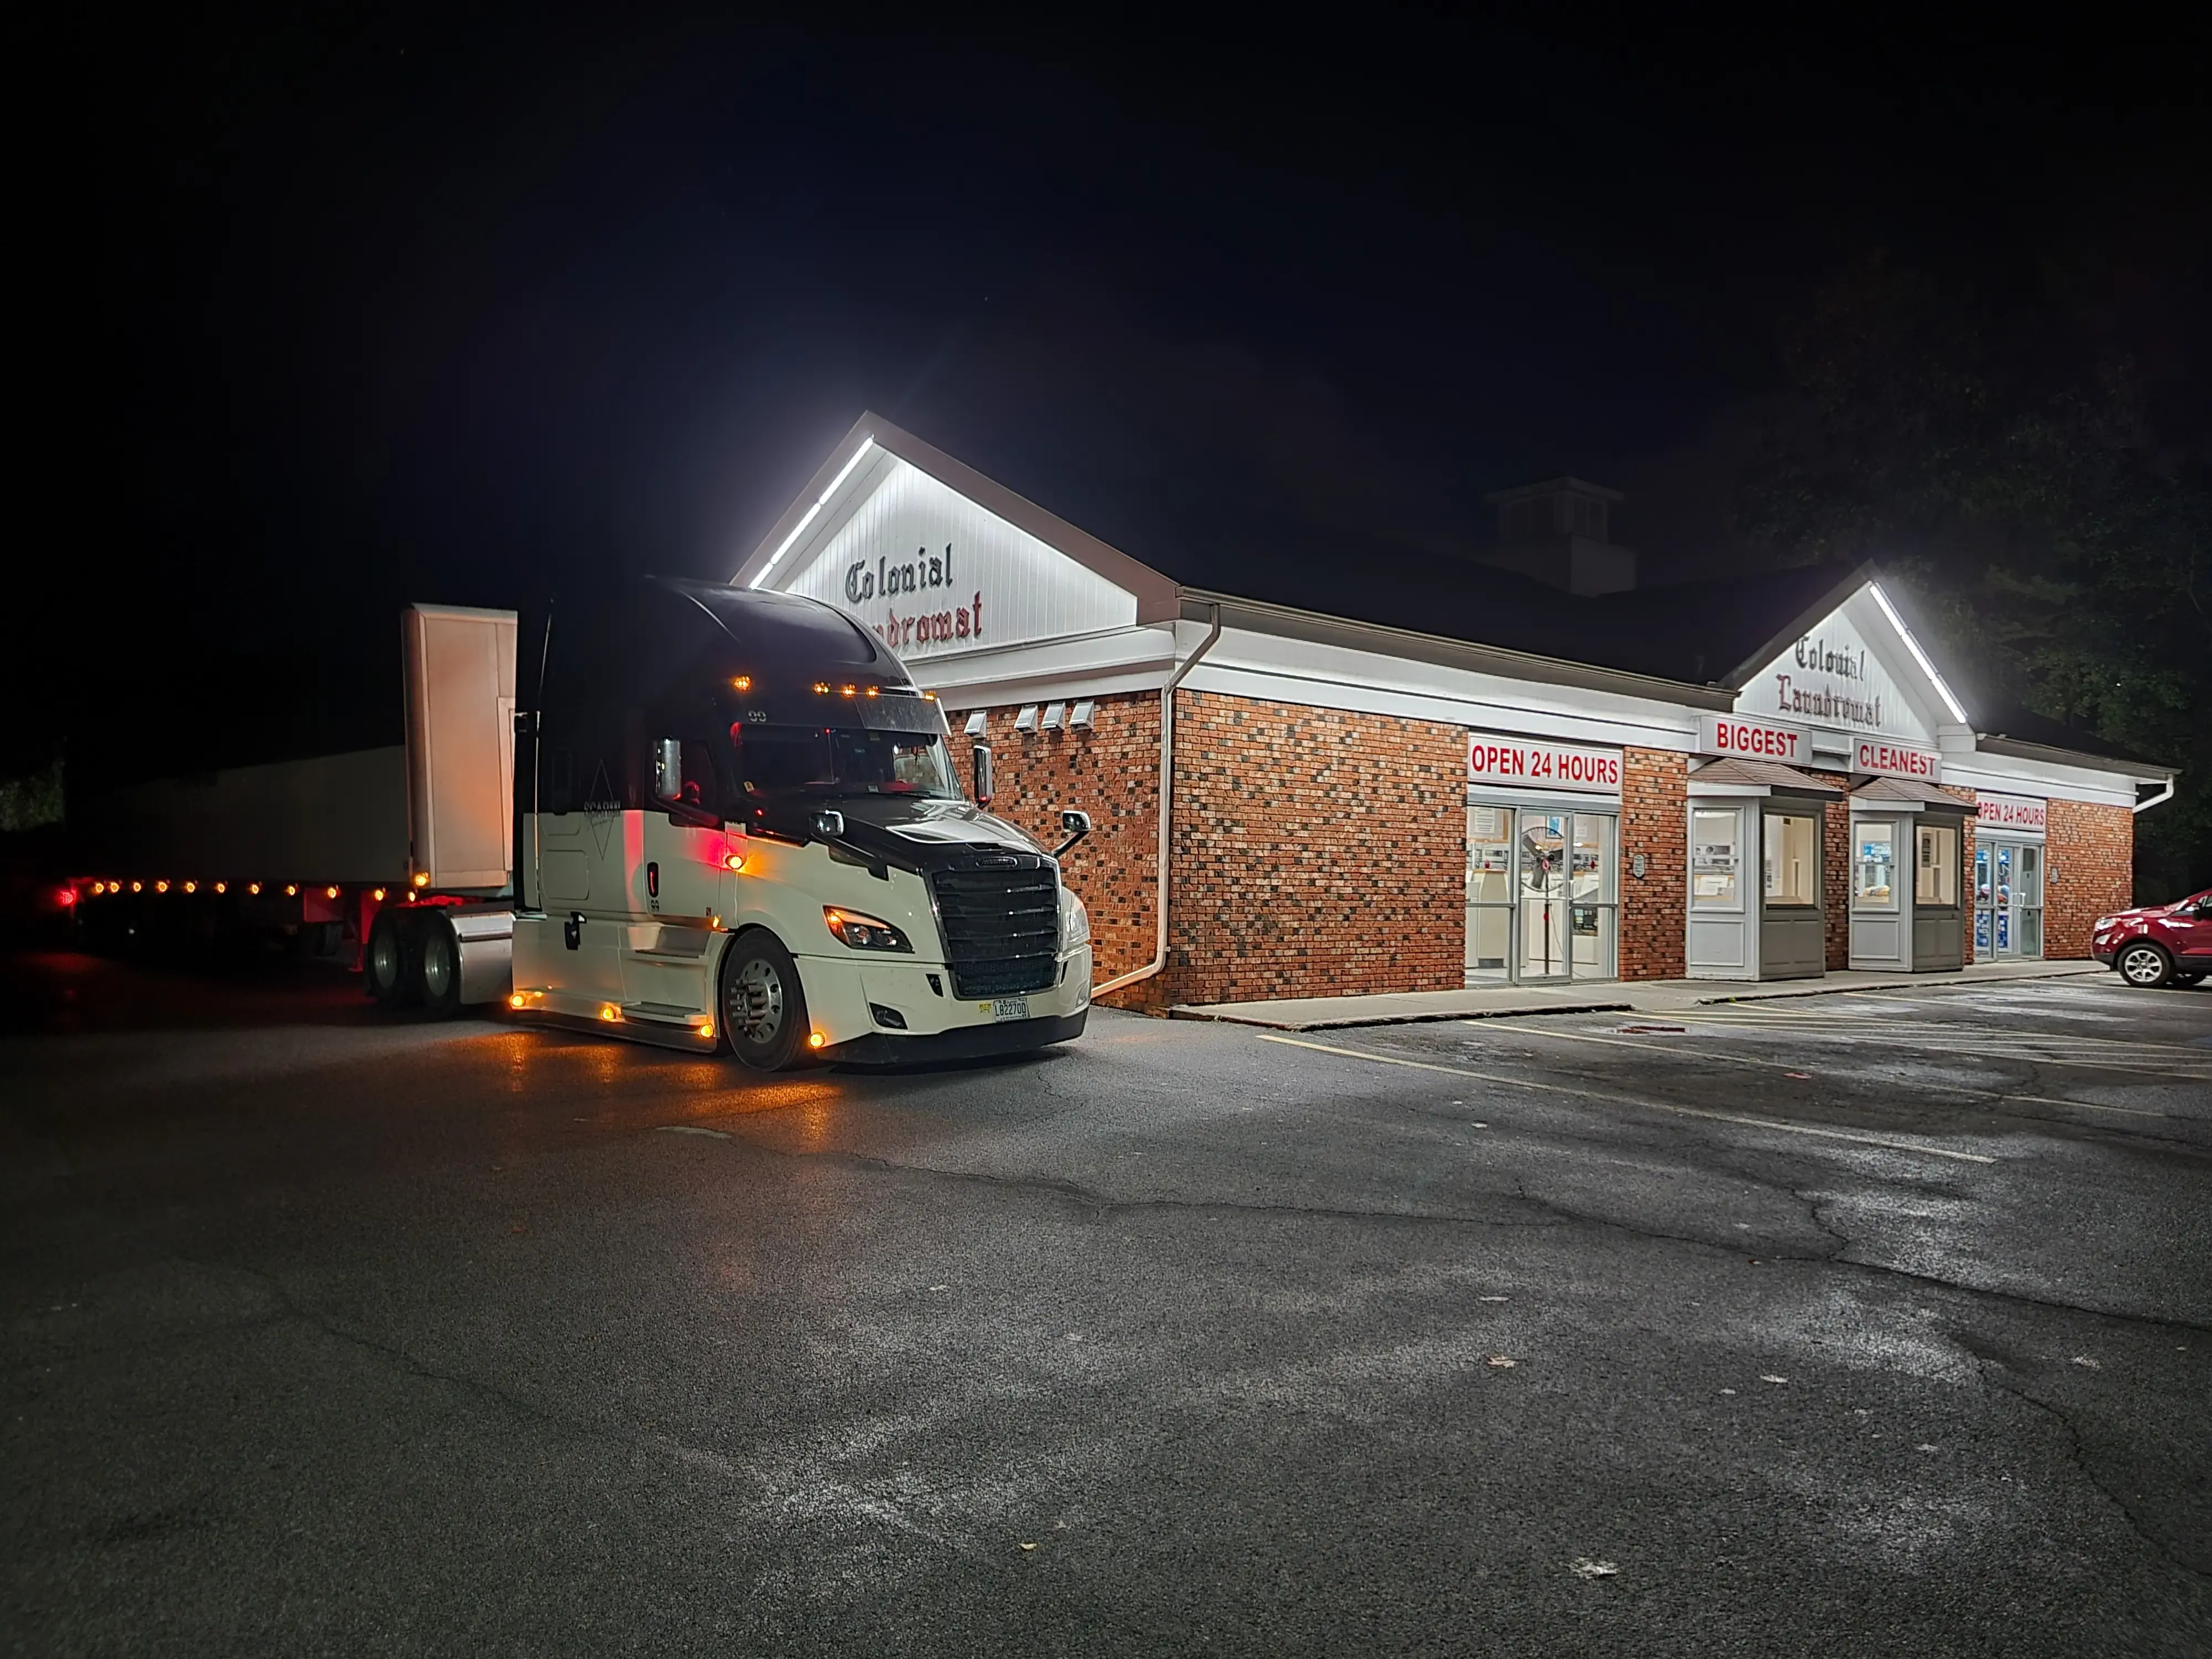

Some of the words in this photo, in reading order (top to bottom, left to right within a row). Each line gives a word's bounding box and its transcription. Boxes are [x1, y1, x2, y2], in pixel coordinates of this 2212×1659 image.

[846, 543, 952, 603] Colonial
[872, 591, 982, 649] ndromat
[1796, 635, 1864, 681] Colonial
[1776, 674, 1881, 727] Laundromat
[1717, 723, 1797, 758] BIGGEST
[1859, 744, 1936, 776] CLEANEST
[1472, 745, 1524, 775] OPEN
[1531, 751, 1552, 778] 24
[1558, 754, 1618, 784] HOURS
[2004, 805, 2013, 823] 24
[2016, 806, 2044, 826] HOURS
